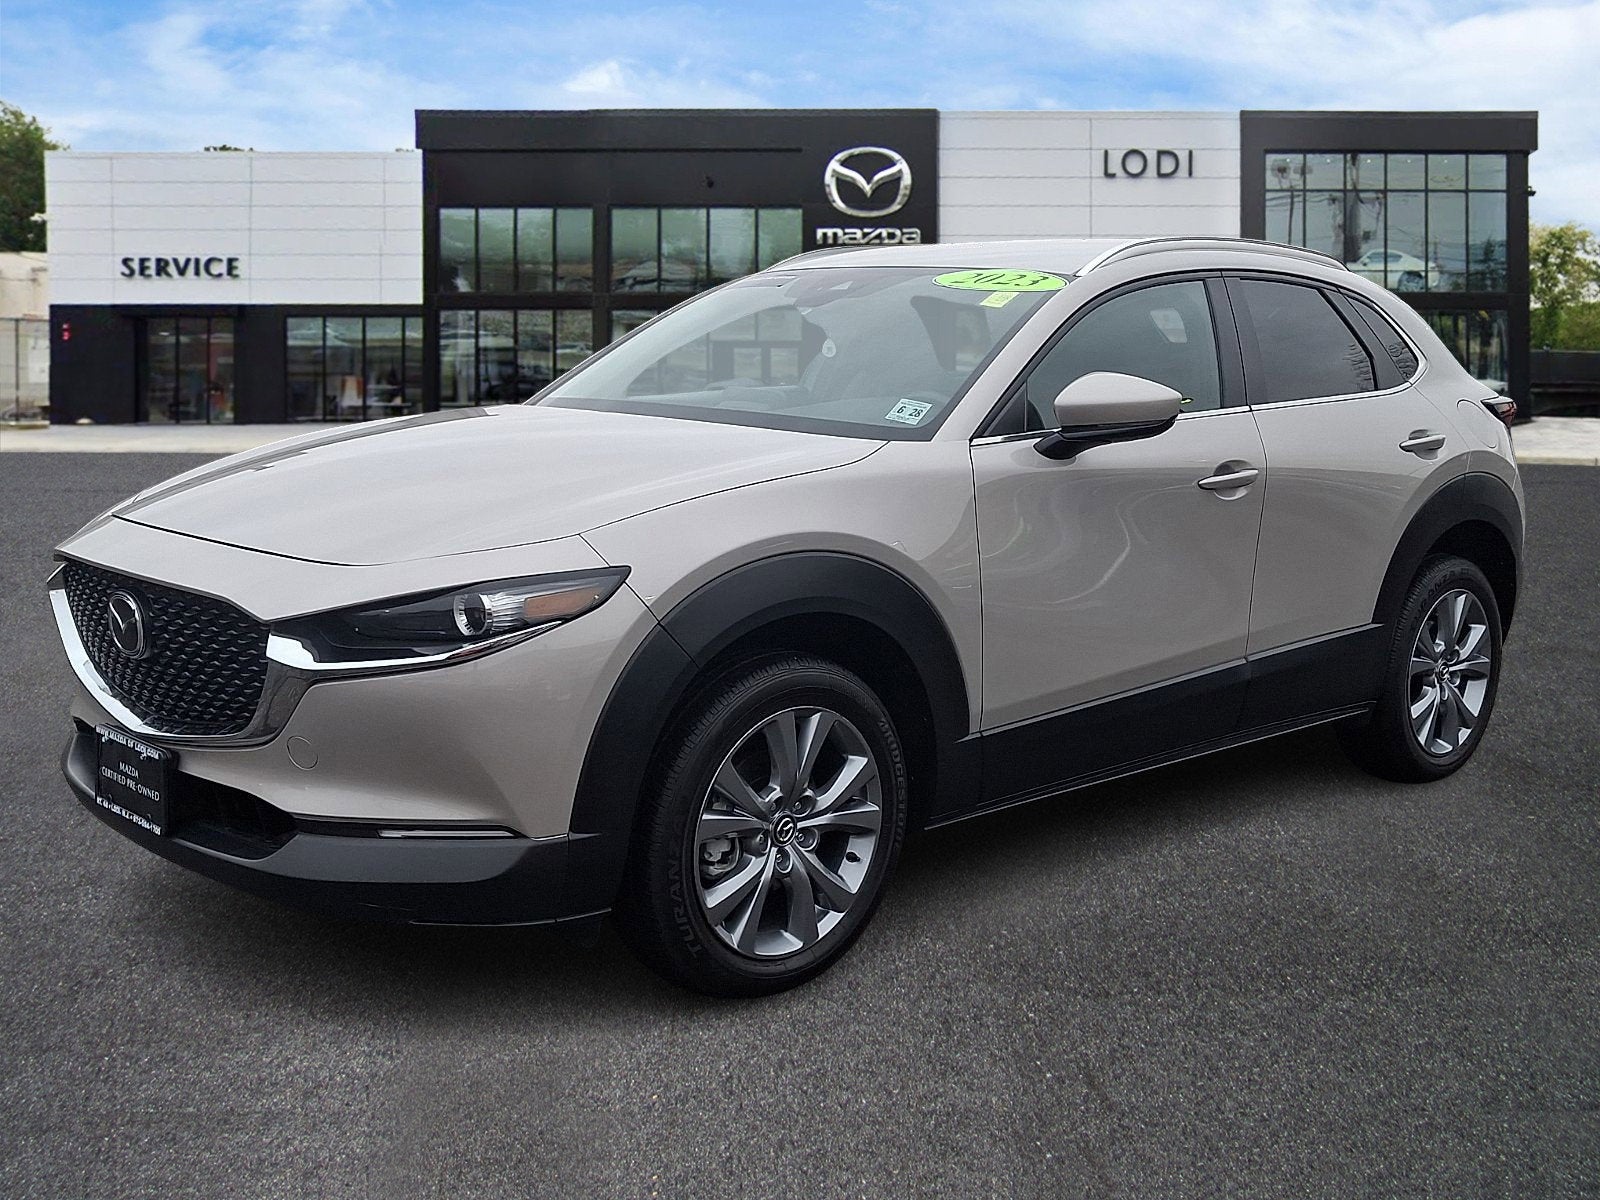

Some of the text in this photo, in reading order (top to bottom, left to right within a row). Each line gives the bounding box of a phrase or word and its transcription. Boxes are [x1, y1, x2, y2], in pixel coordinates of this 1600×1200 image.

[1103, 149, 1193, 178] LODI
[120, 257, 240, 278] SERVICE
[950, 273, 1049, 287] 2023
[897, 405, 907, 414] 6
[119, 760, 139, 780] MAZDA
[101, 766, 160, 802] CERTIFIED PRE-OWNED
